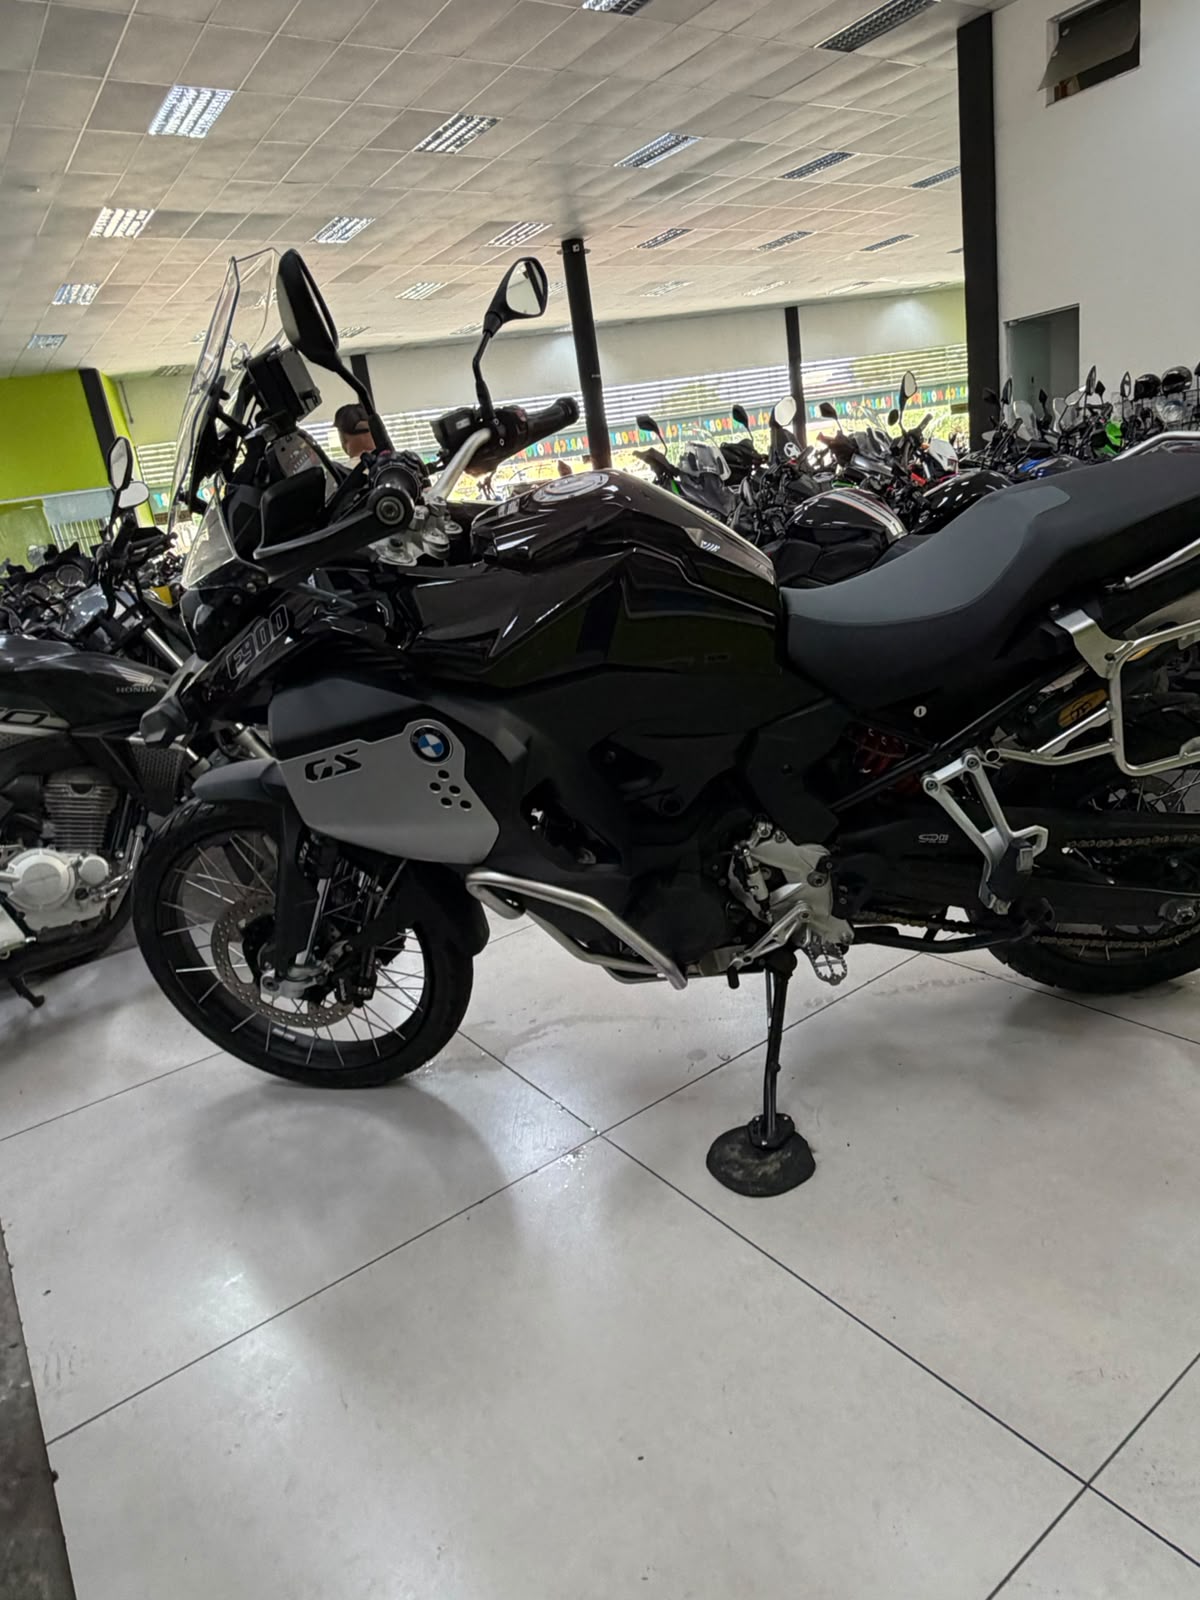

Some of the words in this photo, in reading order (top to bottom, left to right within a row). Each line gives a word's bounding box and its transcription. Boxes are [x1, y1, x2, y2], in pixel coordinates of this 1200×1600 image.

[225, 603, 290, 680] F900
[116, 685, 157, 693] HONDA
[304, 748, 362, 782] GS
